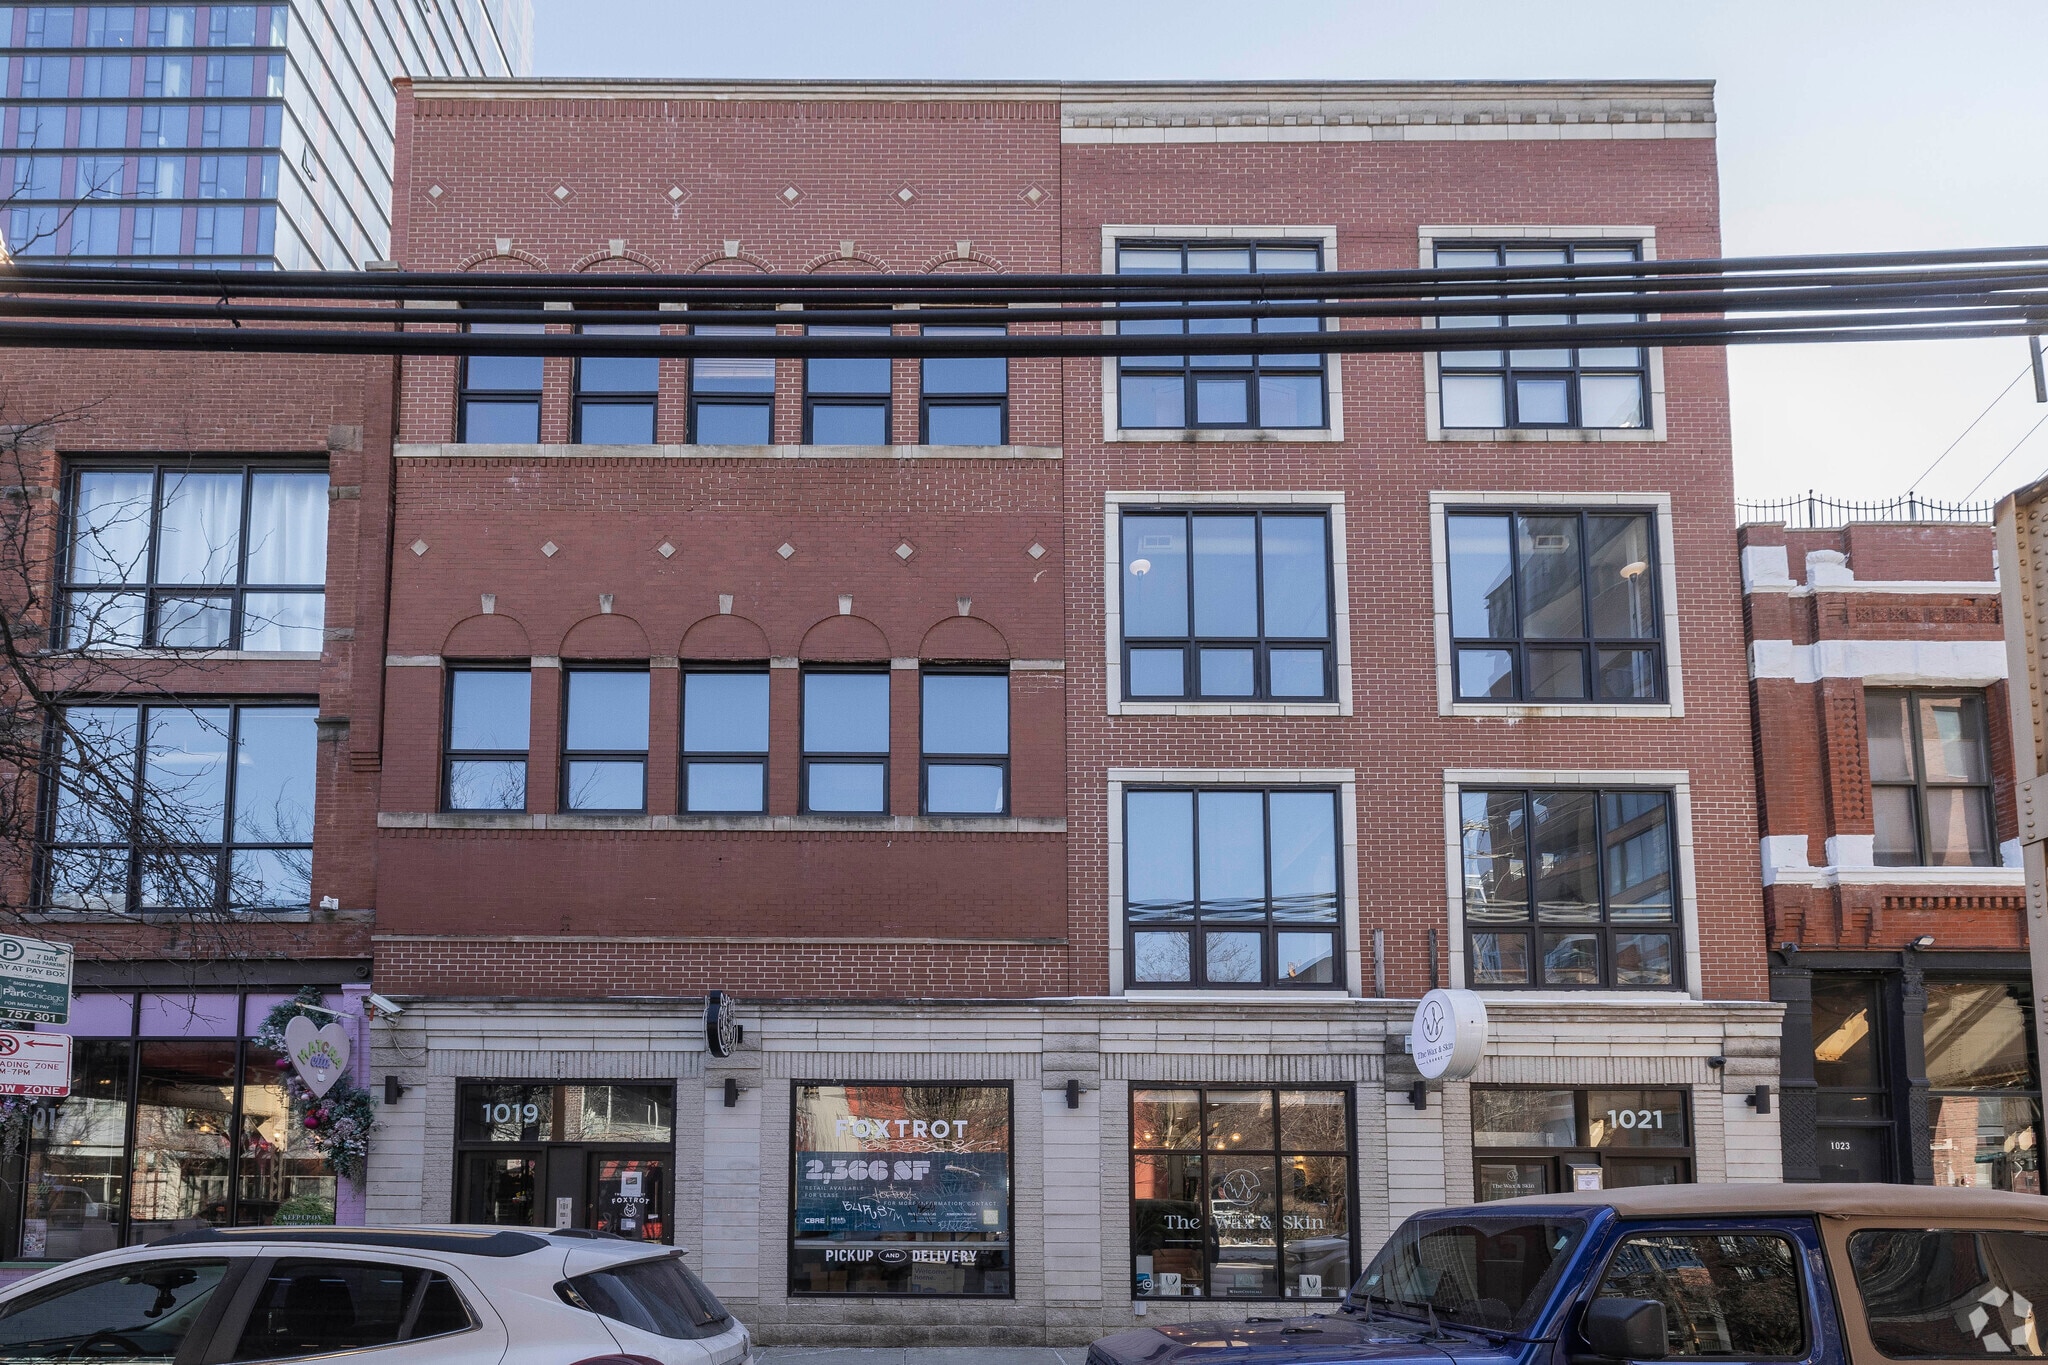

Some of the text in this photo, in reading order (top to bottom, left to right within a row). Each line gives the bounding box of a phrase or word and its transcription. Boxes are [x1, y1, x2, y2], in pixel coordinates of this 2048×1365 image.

[46, 970, 65, 978] BOX
[3, 986, 65, 1003] ParkChicago
[17, 1001, 38, 1009] MOBILE
[7, 1009, 56, 1022] 757 301
[297, 1039, 343, 1070] MATCHA
[1417, 1051, 1427, 1060] The
[1426, 1047, 1438, 1056] Wax
[1442, 1042, 1454, 1051] Skin
[0, 1061, 60, 1070] ADING ZONE
[23, 1085, 60, 1095] ZONE
[482, 1103, 538, 1124] 1019
[1607, 1109, 1663, 1129] 1021
[835, 1119, 968, 1139] FOXTROT
[1831, 1142, 1850, 1150] 1023
[805, 1159, 931, 1185] 2,366 SF
[1164, 1215, 1325, 1230] The Wax & Skin
[825, 1249, 874, 1262] PICKUP
[912, 1250, 977, 1263] DELIVERY
[914, 1267, 947, 1275] Welcome
